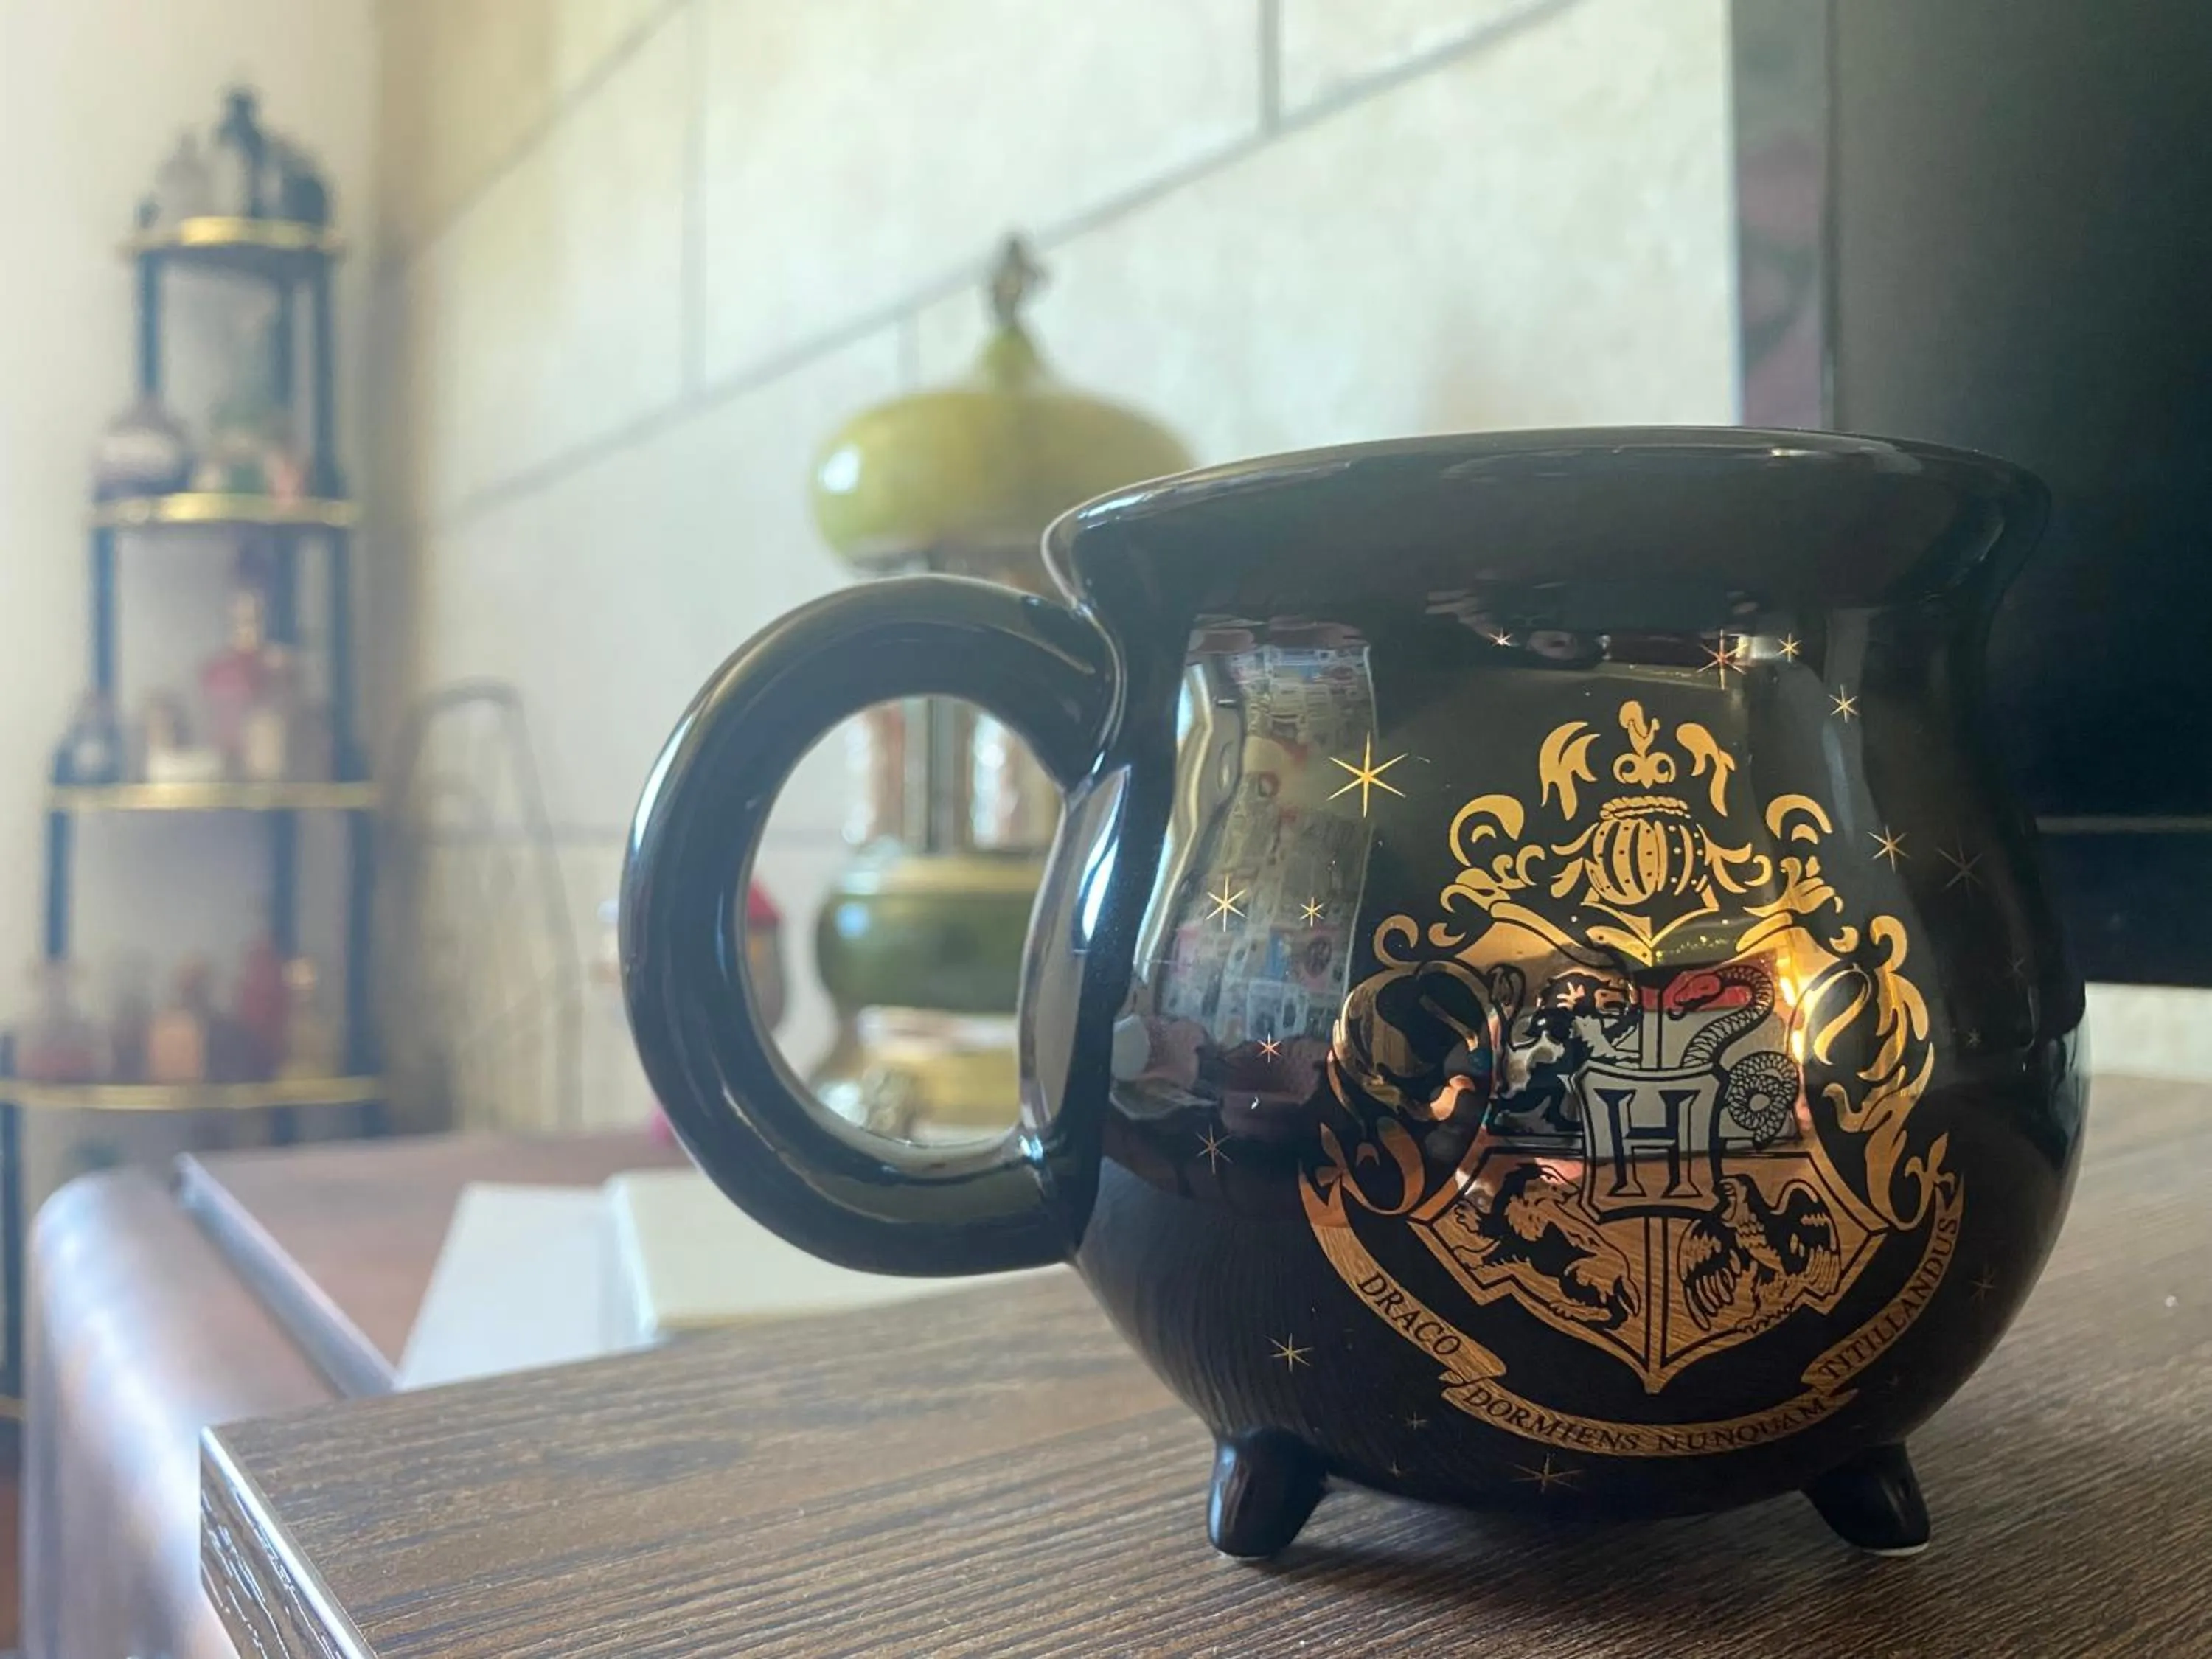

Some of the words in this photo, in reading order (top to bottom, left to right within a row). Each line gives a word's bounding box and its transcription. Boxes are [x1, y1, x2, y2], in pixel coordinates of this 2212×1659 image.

[1593, 1088, 1703, 1199] H
[1358, 1273, 1461, 1356] DRACO
[1462, 1387, 1640, 1452] DORMIENS
[1656, 1397, 1827, 1453] NUNQUAM
[1818, 1218, 1956, 1380] TITILLANDUS
